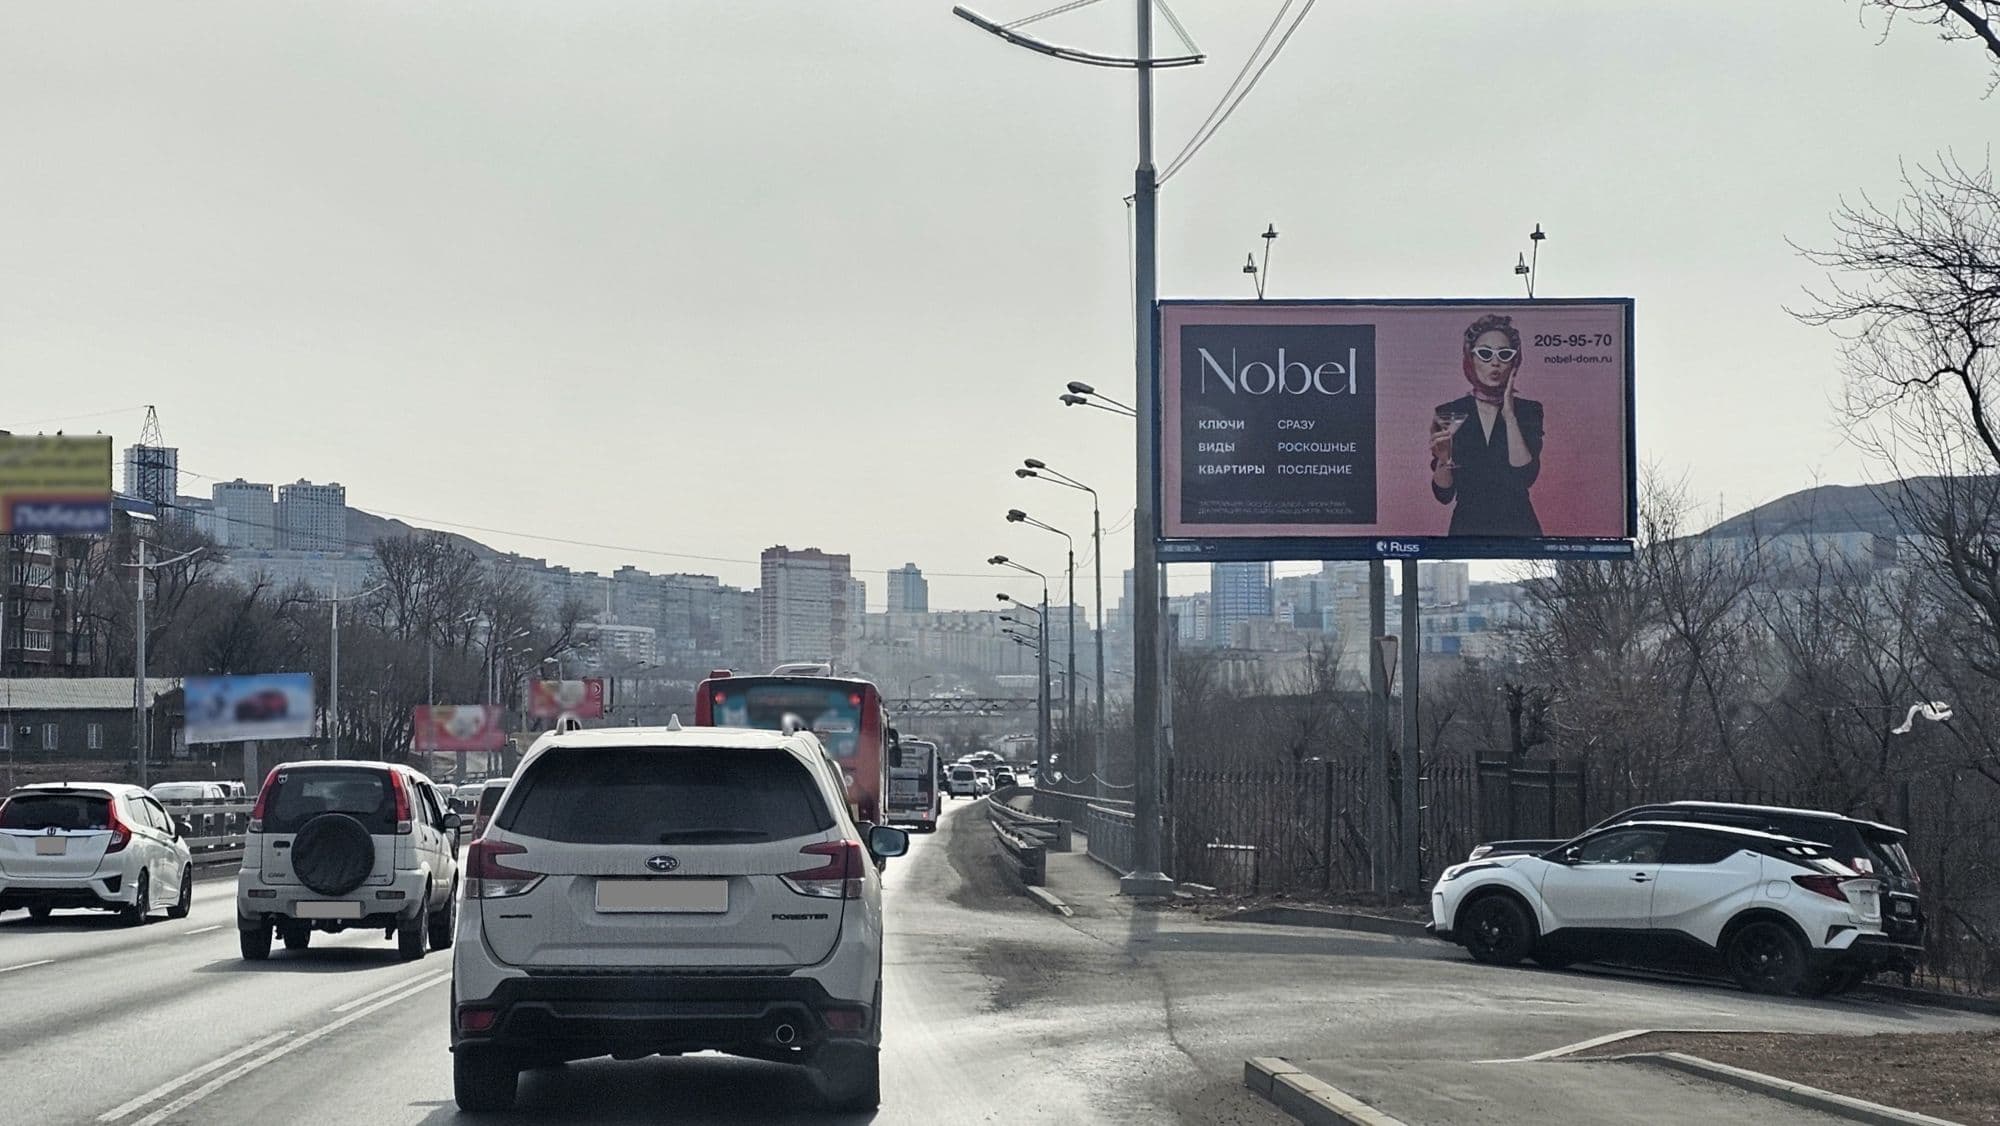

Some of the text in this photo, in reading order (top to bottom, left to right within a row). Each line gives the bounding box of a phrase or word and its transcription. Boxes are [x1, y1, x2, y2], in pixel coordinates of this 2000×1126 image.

[1534, 333, 1613, 347] 205-95-70
[1544, 354, 1613, 364] nobel-dom.ru
[1197, 347, 1357, 395] Nobel
[1198, 419, 1316, 430] КЛЮЧИ СРАЗУ
[1198, 442, 1357, 453] ВИДЫ РОСКОШНЫЕ
[1198, 464, 1352, 475] КВАРТИРЫ ПОСЛЕДНИЕ
[1390, 541, 1420, 552] Russ
[771, 913, 829, 921] FORESTER
